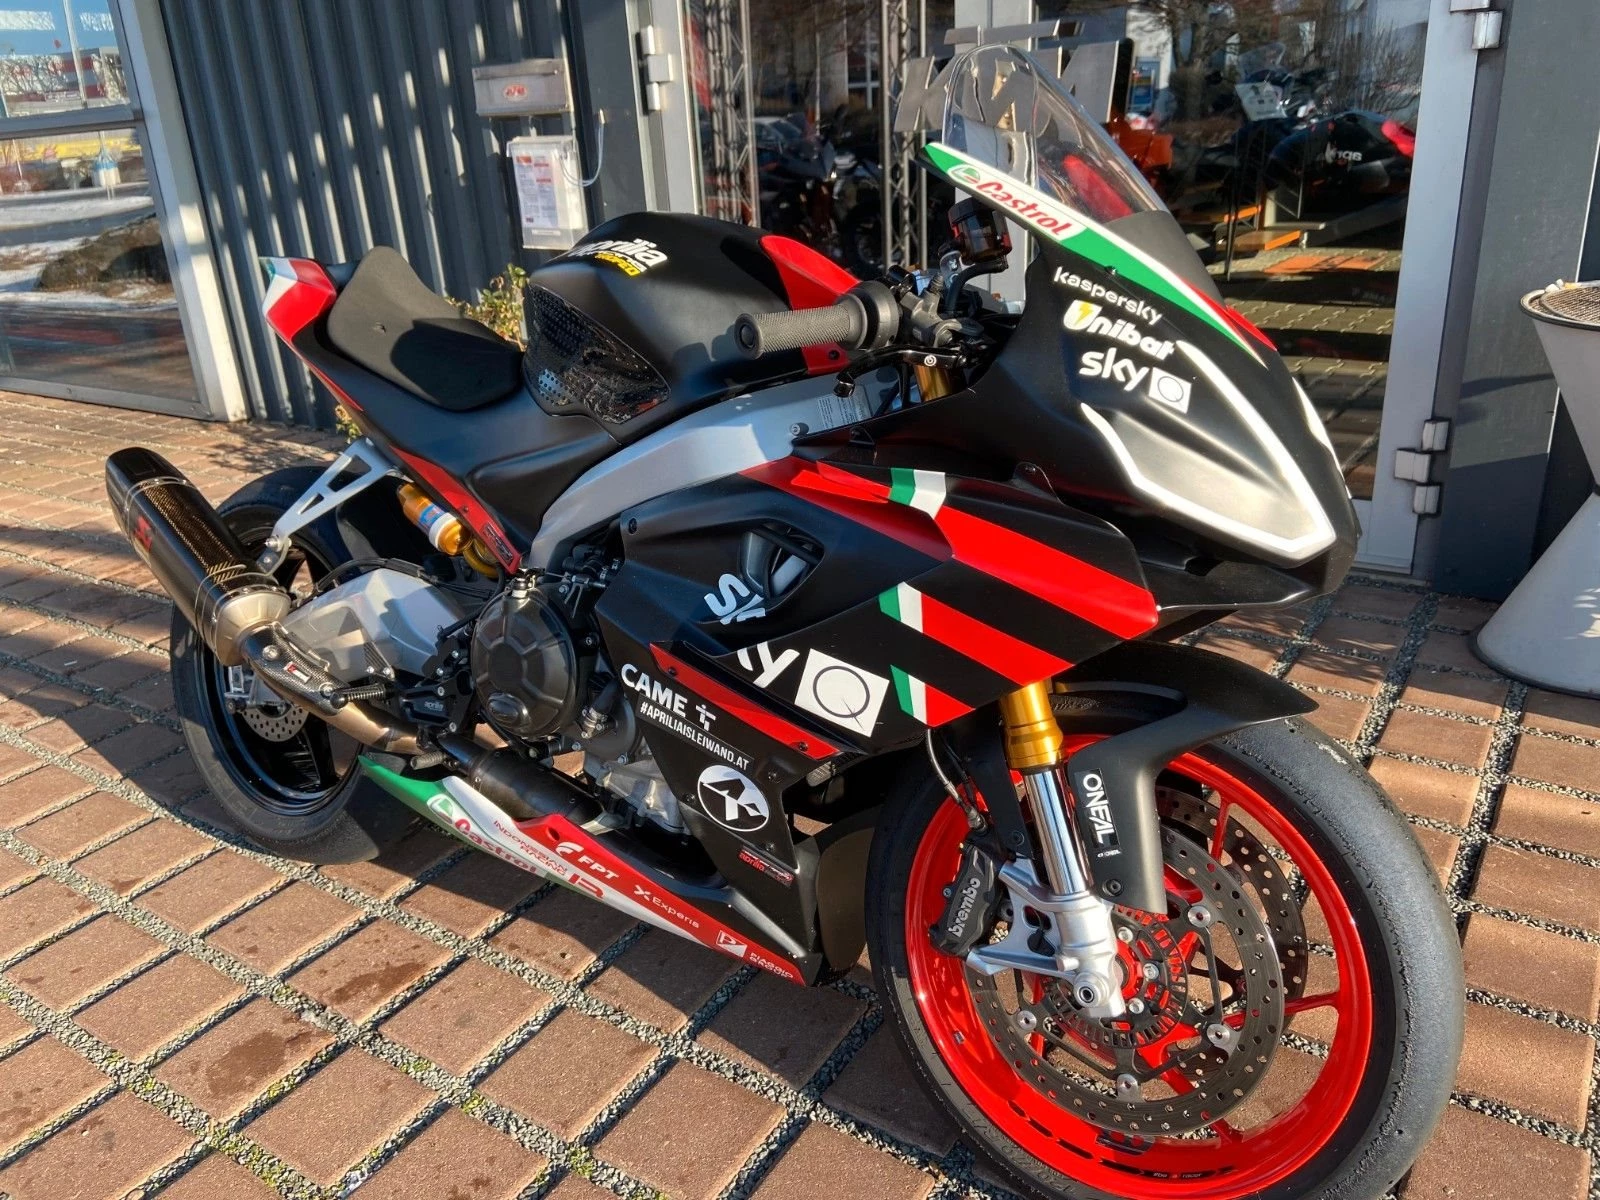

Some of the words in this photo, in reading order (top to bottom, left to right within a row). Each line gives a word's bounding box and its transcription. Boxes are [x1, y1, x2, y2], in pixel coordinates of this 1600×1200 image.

[976, 181, 1072, 236] Castrol
[1053, 266, 1163, 325] kaspersky
[1063, 299, 1175, 361] Unibat
[1078, 347, 1150, 391] sky
[621, 663, 688, 718] CAME
[640, 701, 750, 771] #APRILIAISLEIWAND.AT
[455, 818, 538, 875] Castrol
[493, 819, 568, 872] INDONESIAN
[519, 845, 567, 876] RACING
[577, 855, 619, 880] FPT
[652, 896, 700, 929] Experis
[948, 877, 981, 938] brembo
